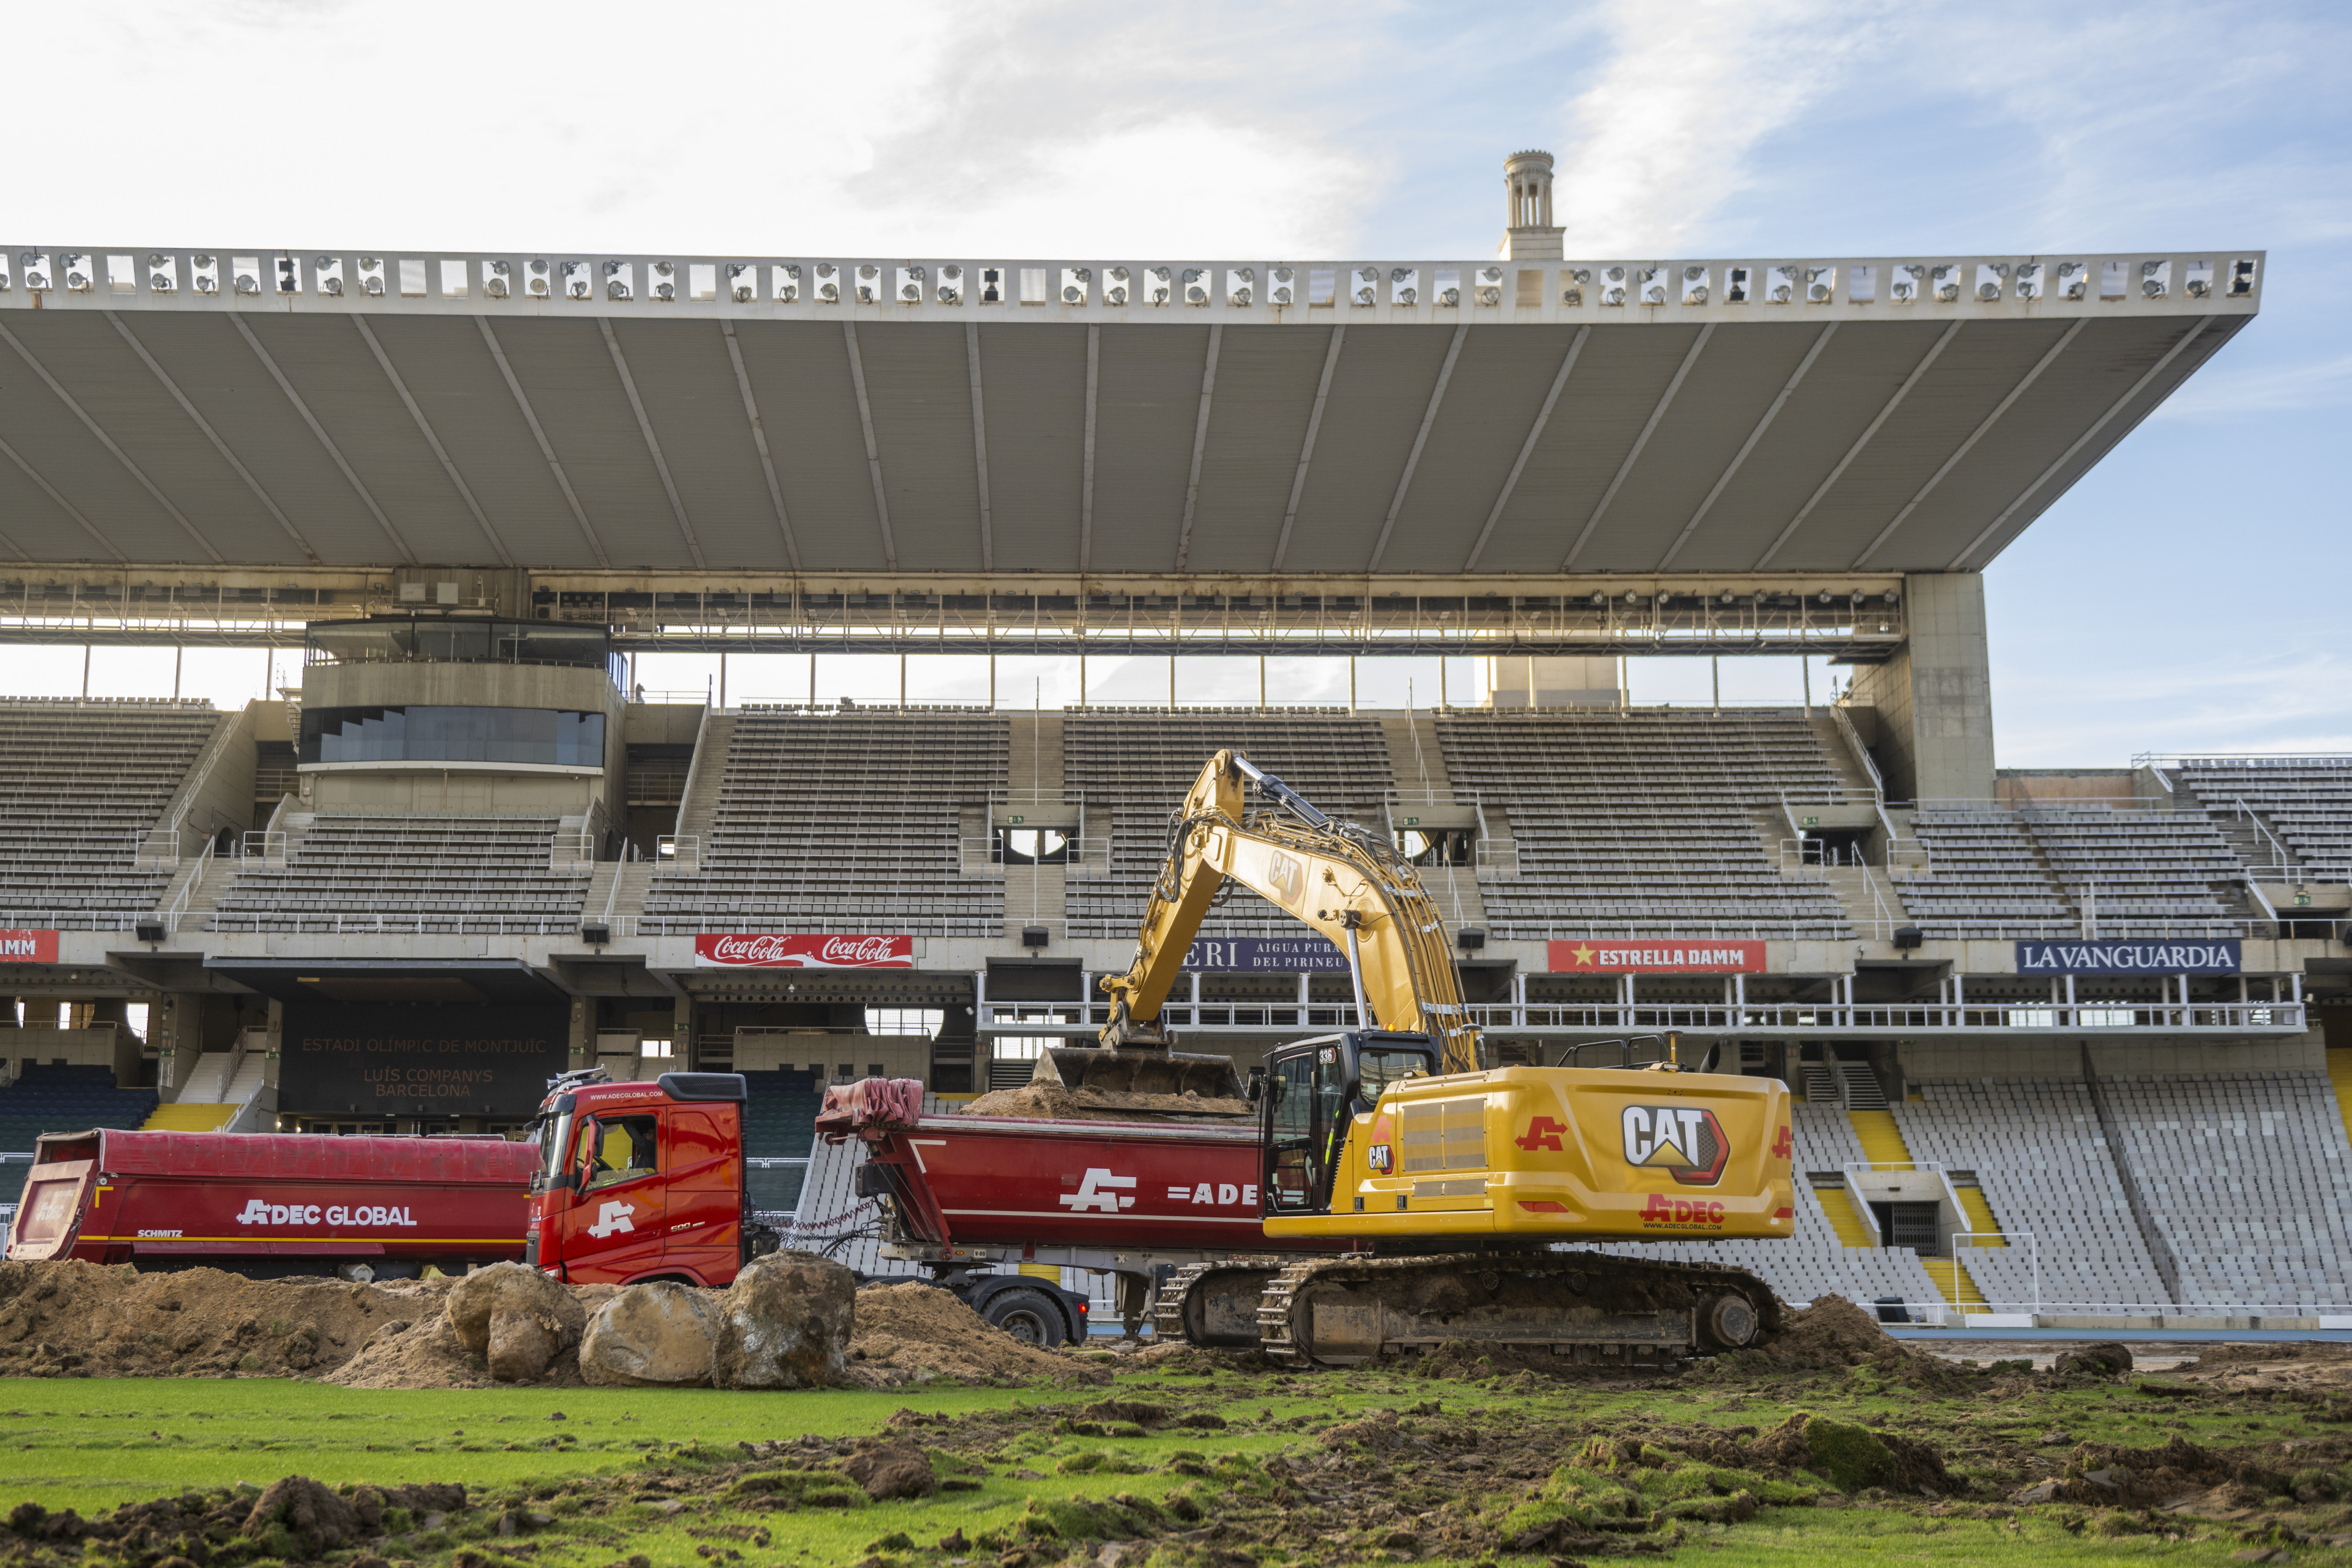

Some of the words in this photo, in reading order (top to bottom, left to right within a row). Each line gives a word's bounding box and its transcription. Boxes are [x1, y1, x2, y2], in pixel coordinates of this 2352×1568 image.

[1269, 852, 1298, 893] CAT
[0, 940, 35, 956] MM
[714, 936, 789, 959] Coca-Cola
[822, 937, 896, 960] Coca-Cola
[1256, 942, 1299, 952] AIGUA
[1305, 943, 1340, 952] PURA
[1253, 957, 1279, 967] DEL
[1285, 958, 1344, 967] PIRINEU
[1599, 950, 1684, 965] ESTRELLA
[1688, 950, 1743, 965] DAMM
[2023, 946, 2058, 968] LA
[2057, 945, 2234, 968] VANGUARDIA
[302, 1038, 361, 1051] ESTADI
[367, 1037, 433, 1052] OLÍMPIC
[439, 1040, 459, 1052] DE
[466, 1038, 546, 1053] MONTJUÏC
[1319, 1049, 1332, 1064] 336
[364, 1066, 400, 1082] LUÍS
[406, 1069, 493, 1082] COMPANYS
[376, 1084, 470, 1097] BARCELONA
[590, 1092, 663, 1100] WWW.ADECGLOBAL.COM
[1623, 1106, 1702, 1166] CAT
[1369, 1146, 1388, 1169] CAT
[1192, 1183, 1280, 1205] ADE
[236, 1199, 321, 1225] ADEC
[326, 1206, 417, 1225] GLOBAL
[1638, 1193, 1725, 1223] ADEC
[138, 1229, 183, 1238] SCHMITZ
[671, 1222, 690, 1232] 500
